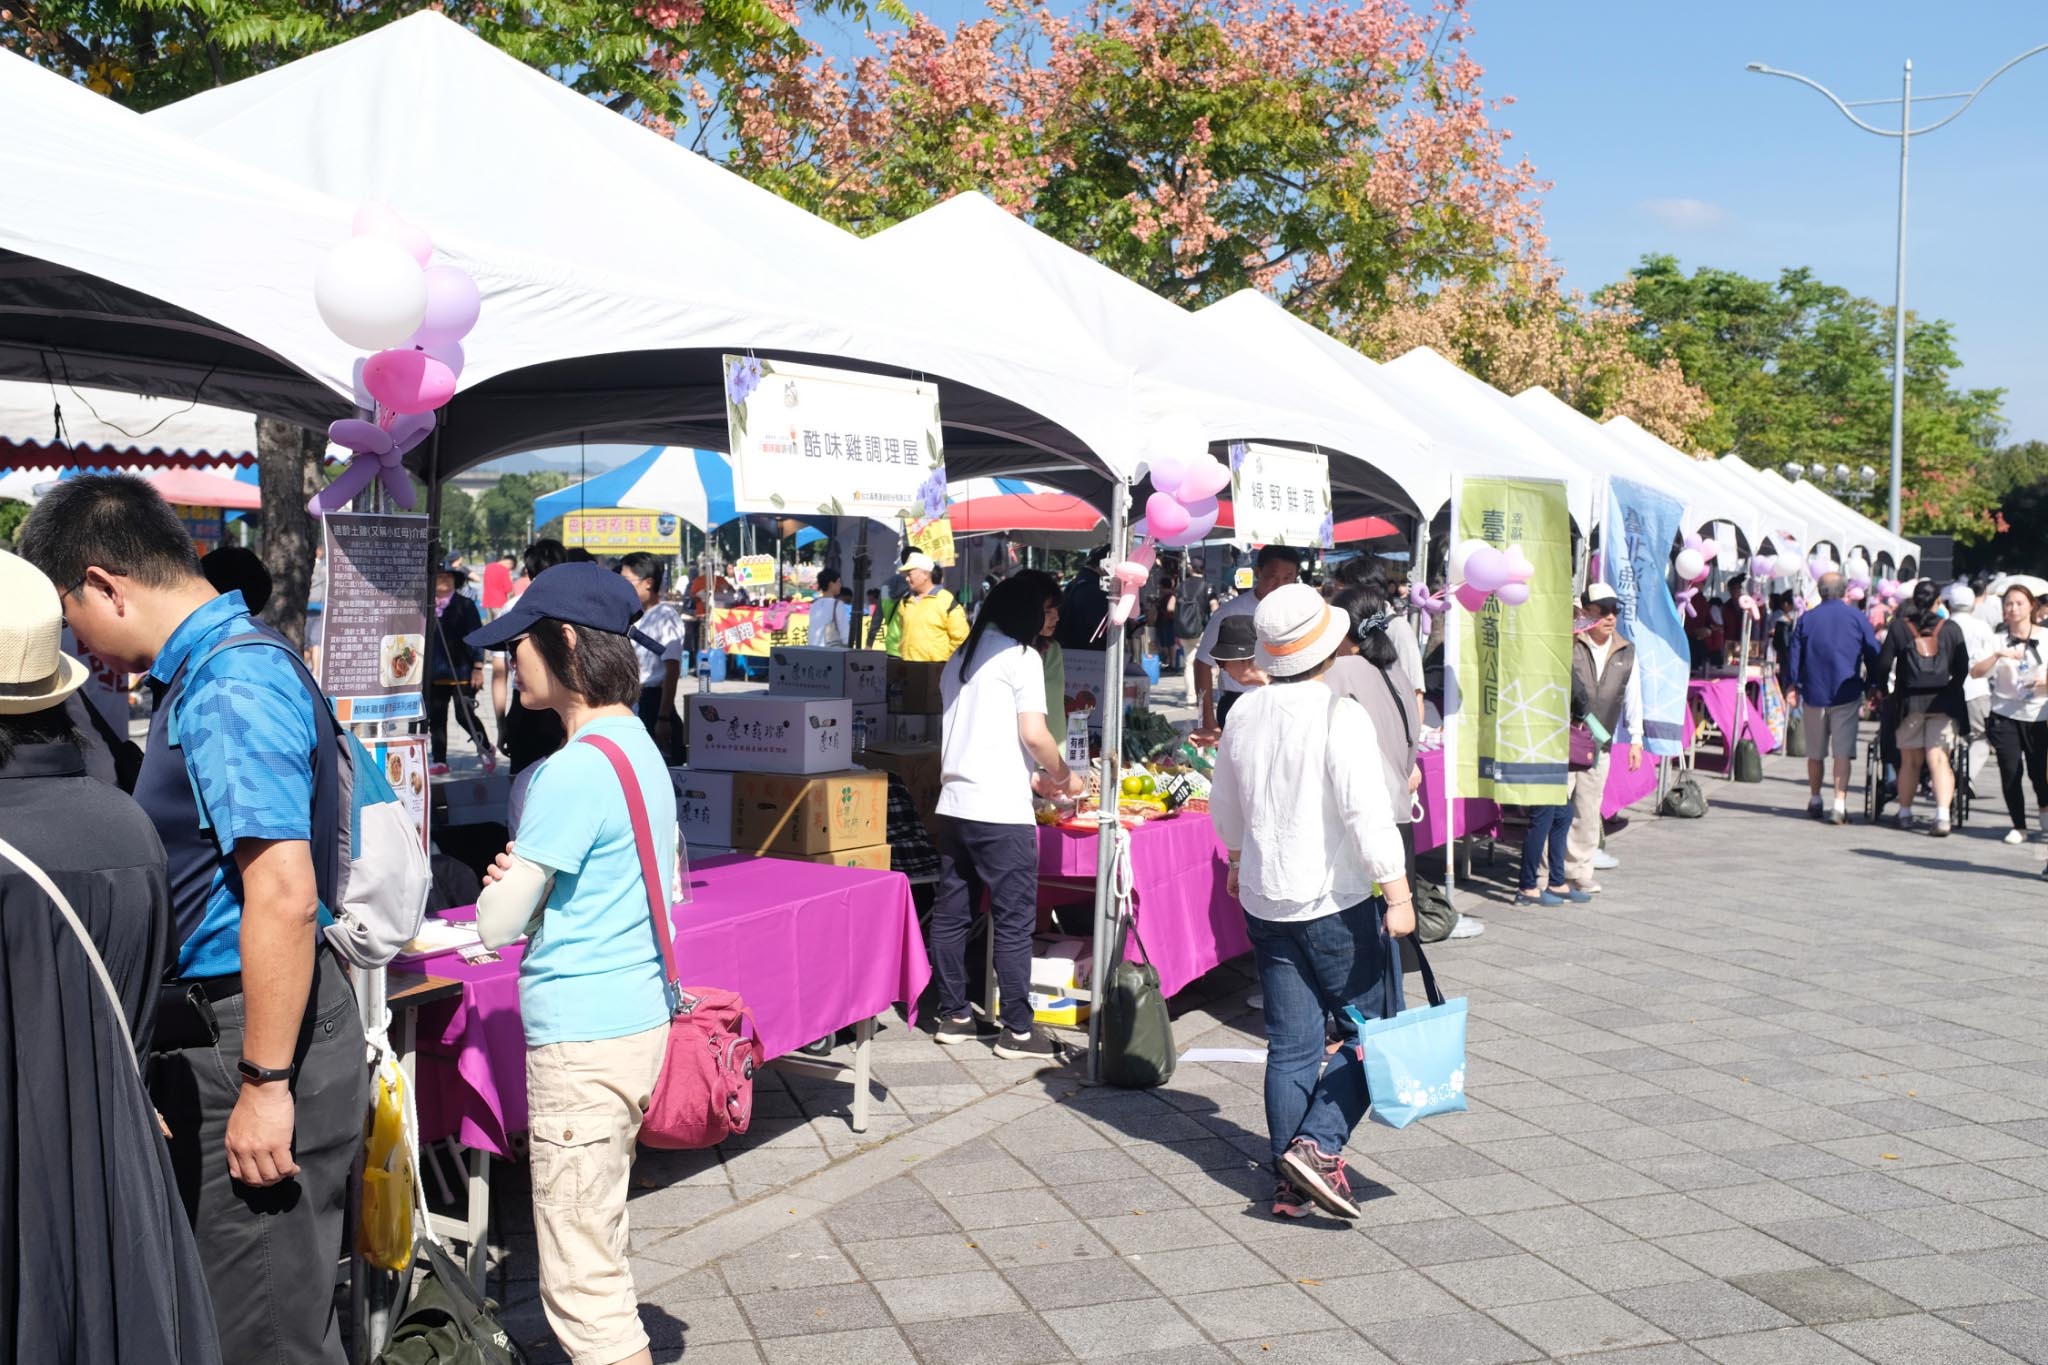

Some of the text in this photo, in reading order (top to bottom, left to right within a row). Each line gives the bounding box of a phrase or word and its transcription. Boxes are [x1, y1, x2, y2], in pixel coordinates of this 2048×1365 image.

[803, 430, 920, 466] 酷味雞調理屋
